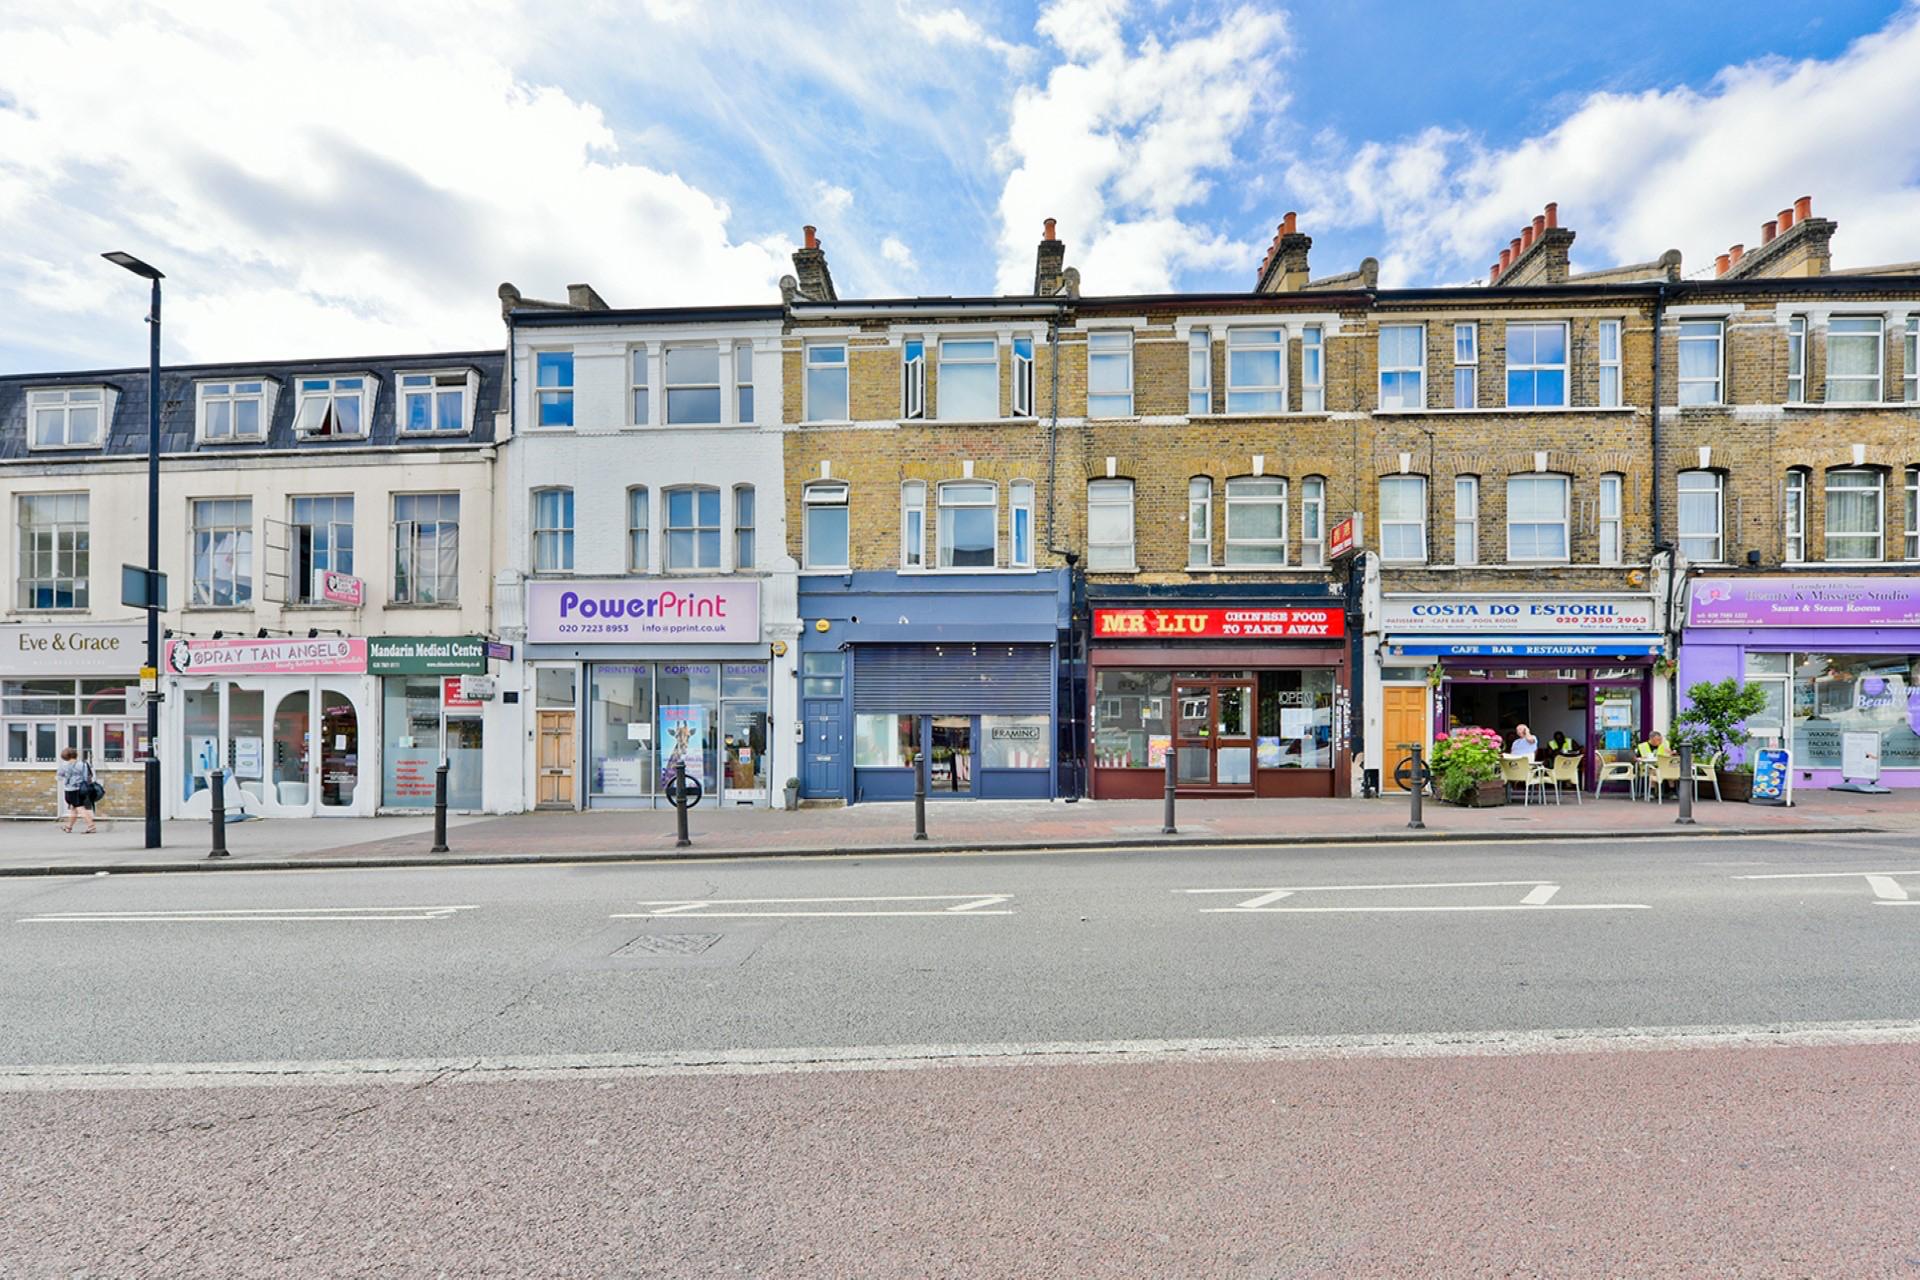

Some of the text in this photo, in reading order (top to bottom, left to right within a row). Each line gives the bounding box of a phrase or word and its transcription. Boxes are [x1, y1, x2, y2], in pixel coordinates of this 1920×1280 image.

[1795, 591, 1804, 601] &
[1812, 590, 1863, 603] Massage
[1868, 590, 1910, 600] Studio
[560, 591, 727, 619] PowerPrint
[1412, 604, 1619, 616] COSTA DO ESTORIL
[1771, 603, 1881, 612] Sauna & Steam Rooms
[1225, 612, 1328, 622] CHINESE FOOD
[559, 624, 578, 633] 020
[581, 624, 604, 633] 7223
[605, 624, 629, 633] 8953
[1101, 614, 1208, 633] MR LIU
[1222, 624, 1329, 634] TO TAKE AWAY
[19, 632, 120, 651] Eve & Grace
[251, 647, 281, 660] TAN
[371, 643, 415, 657] Mandarin
[415, 643, 450, 657] Medical
[451, 642, 483, 657] Centre
[1451, 645, 1597, 654] CAFE BAR RESTAURANT
[598, 665, 646, 674] PRINTING
[664, 665, 711, 674] COPYING
[727, 665, 766, 674] DESIGN
[1279, 691, 1313, 705] OPEN
[994, 729, 1038, 739] FRAMING
